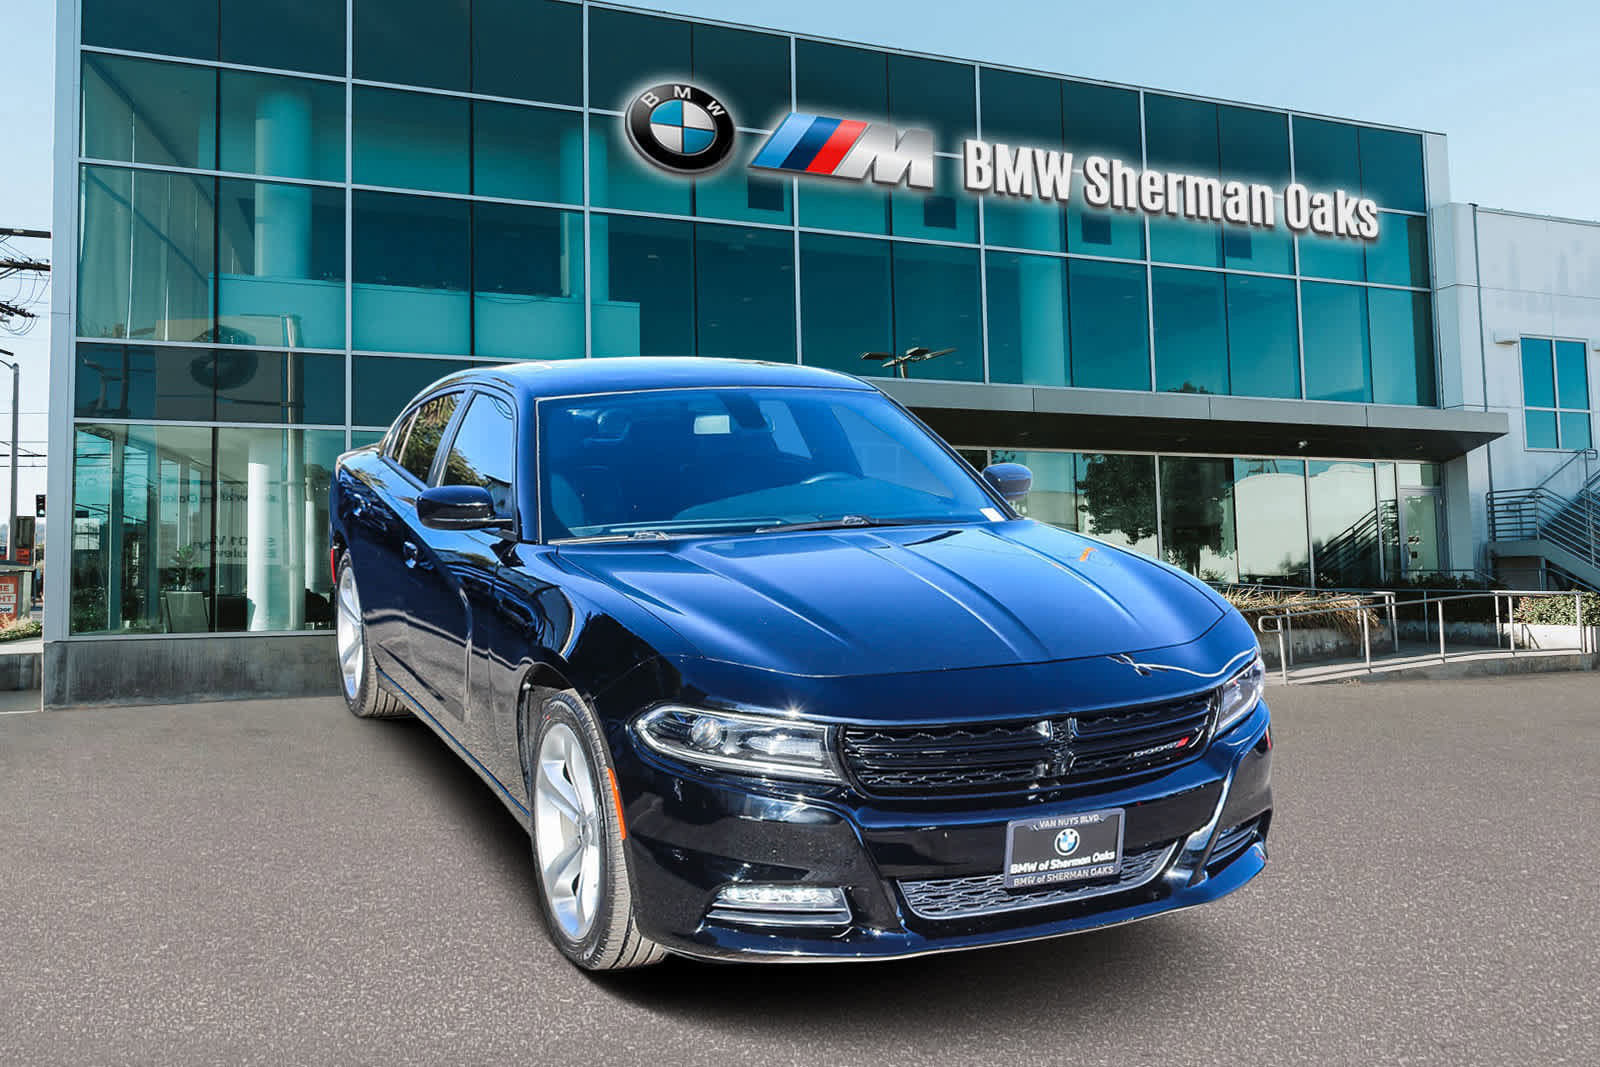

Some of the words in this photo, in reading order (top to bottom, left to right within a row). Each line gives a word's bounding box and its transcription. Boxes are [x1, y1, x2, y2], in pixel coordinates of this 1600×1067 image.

[641, 85, 725, 117] BMW
[963, 139, 1073, 201] BMW
[1083, 155, 1274, 228] Sherman
[1283, 182, 1379, 242] Oaks
[1039, 818, 1057, 828] VAN
[1058, 815, 1079, 826] NUYS
[1010, 861, 1037, 874] BMW
[1038, 860, 1049, 871] of
[1051, 856, 1091, 870] Sherman
[1092, 850, 1115, 863] Oaks
[1013, 875, 1036, 887] BMW
[1036, 874, 1045, 884] of
[1047, 869, 1089, 881] SHERMAN
[1090, 865, 1114, 876] OAKS
